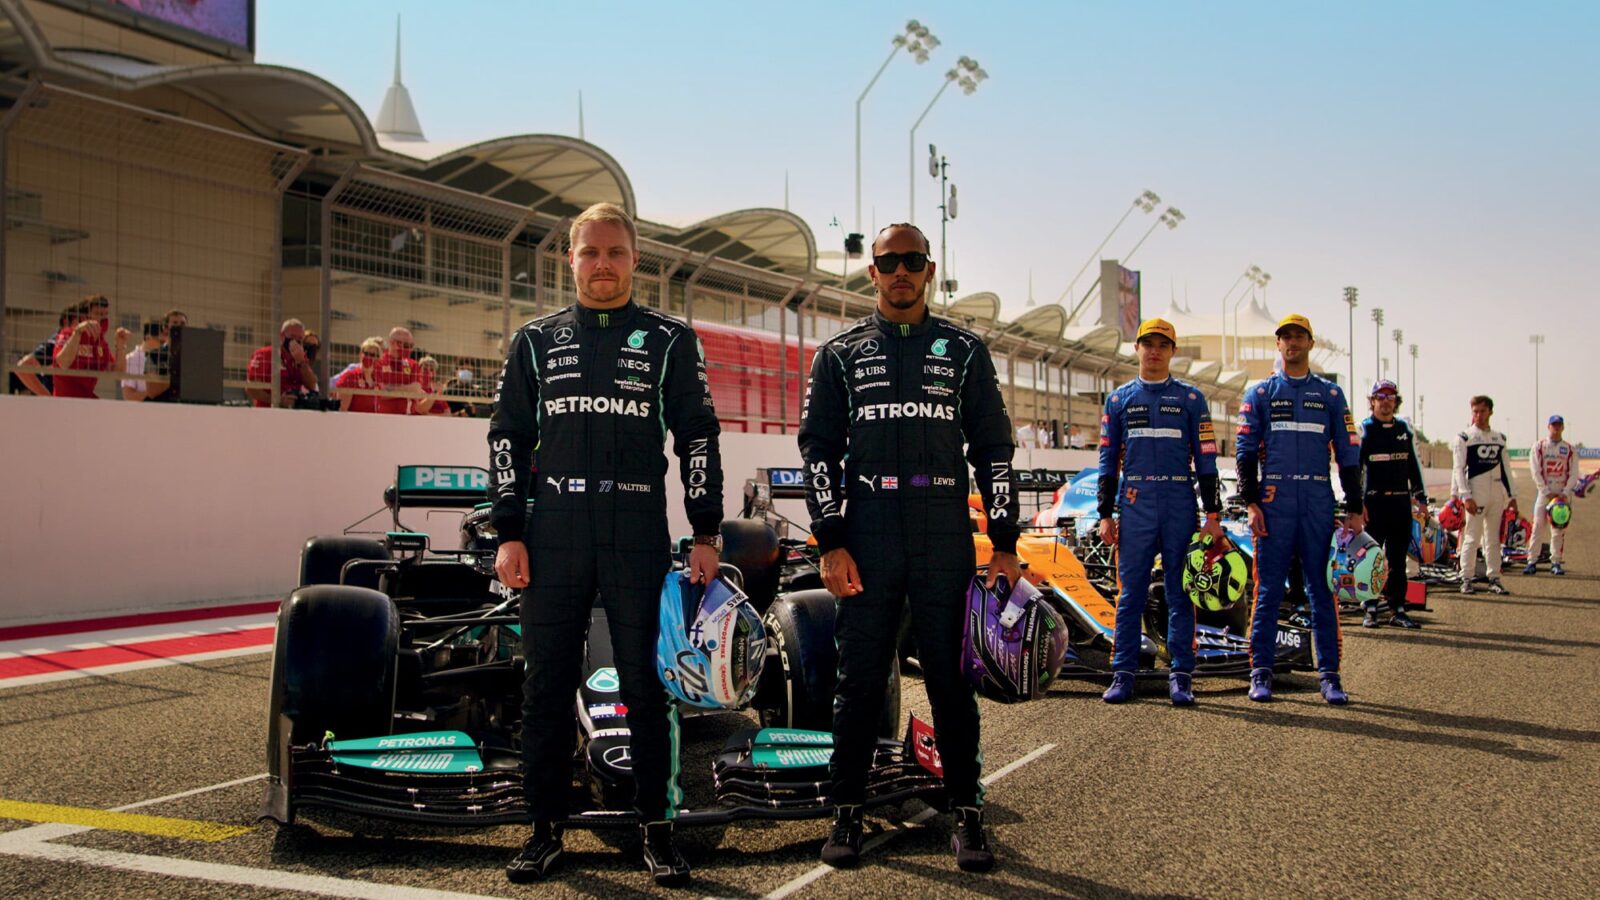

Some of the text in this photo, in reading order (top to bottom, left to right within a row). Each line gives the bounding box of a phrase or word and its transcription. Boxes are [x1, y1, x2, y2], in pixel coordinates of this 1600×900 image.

[620, 347, 649, 355] PETRONAS
[558, 355, 579, 367] UBS
[617, 358, 651, 372] INEOS
[865, 365, 887, 376] UBS
[923, 364, 955, 377] INEOS
[545, 396, 651, 418] PETRONAS
[856, 402, 955, 421] PETRONAS
[415, 467, 490, 487] PETR
[493, 438, 516, 498] INEOS
[689, 437, 709, 499] INEOS
[598, 480, 652, 493] 77 VALTTERI
[810, 460, 841, 519] INEOS
[933, 476, 956, 486] LEWIS
[989, 461, 1011, 520] INEOS
[1125, 486, 1139, 505] 4
[1261, 484, 1277, 503] 3
[720, 611, 732, 659] CROWDSTRIKE
[378, 735, 457, 748] PETRONAS
[767, 732, 834, 744] PETRONAS
